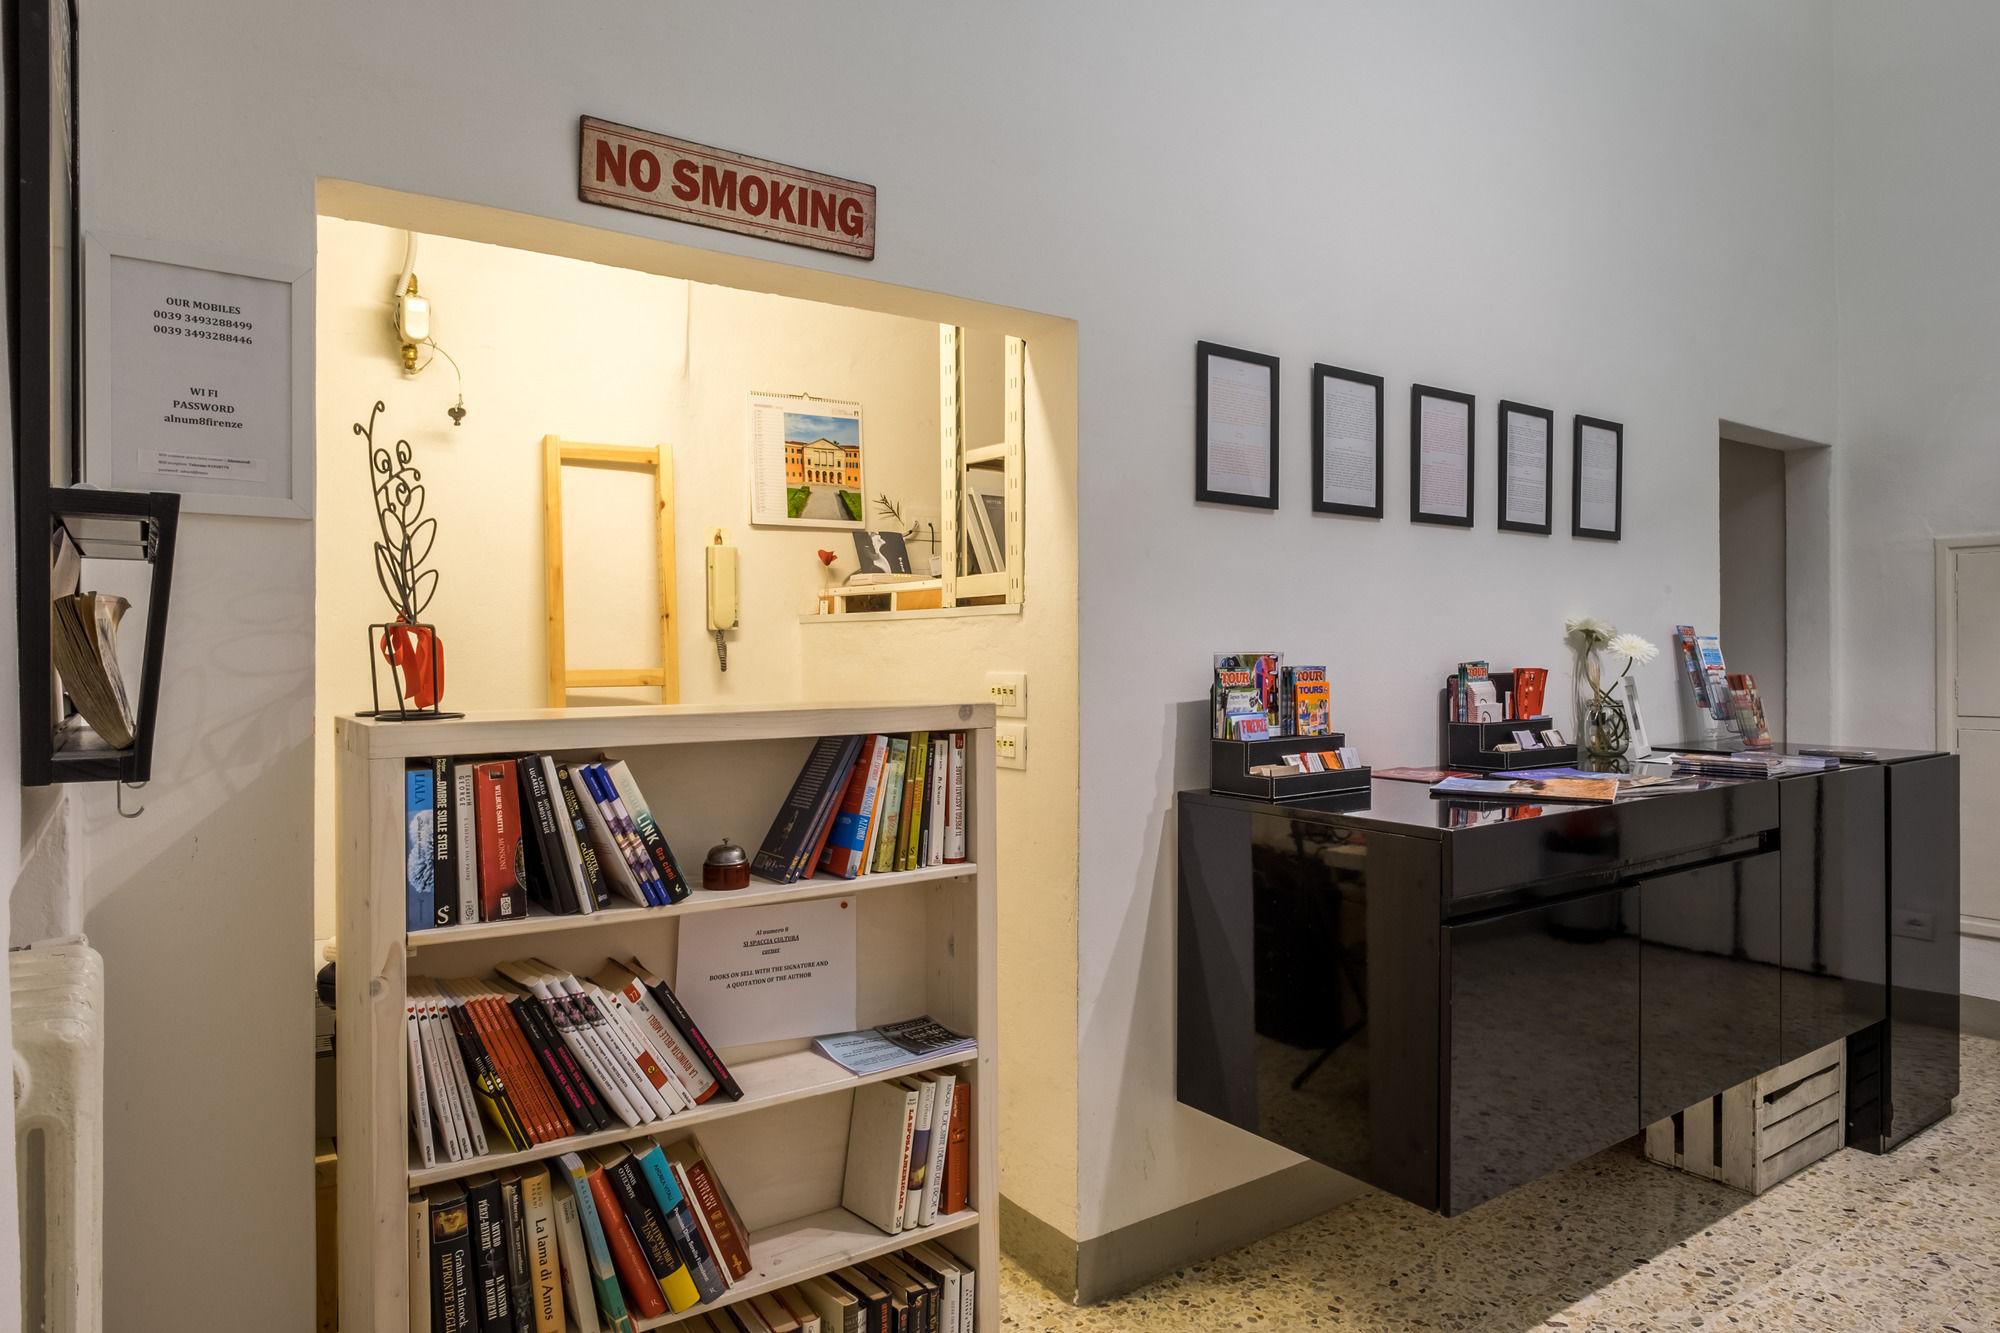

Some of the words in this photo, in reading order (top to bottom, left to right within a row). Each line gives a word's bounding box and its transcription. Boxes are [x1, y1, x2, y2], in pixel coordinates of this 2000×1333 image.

[596, 139, 661, 193] NO
[671, 158, 864, 238] SMOKING
[166, 297, 190, 308] OUR
[193, 301, 241, 315] MOBILES
[153, 309, 182, 321] 0039
[184, 314, 252, 331] 3493288499
[153, 324, 182, 336] 0039
[184, 328, 253, 345] 3493288446
[190, 387, 206, 397] WI
[208, 388, 218, 398] FI
[173, 400, 235, 414] PASSWORD
[163, 414, 243, 429] alnum8firenze
[1220, 672, 1250, 684] TOUR
[1296, 671, 1323, 681] TOUR
[1299, 686, 1323, 694] TOURS
[415, 773, 426, 805] LIALA
[436, 780, 447, 808] OMBRE
[529, 767, 541, 797] LUCARELLI
[537, 777, 546, 796] CARLO
[494, 784, 502, 809] WILBUR
[955, 785, 963, 811] LASCIATI
[437, 809, 447, 833] SULLE
[496, 810, 504, 834] SMITH
[537, 801, 546, 821] ALMOST
[542, 820, 550, 835] BLUE
[636, 814, 660, 846] LINK
[437, 834, 448, 860] STELLE
[586, 847, 597, 871] HOTEL
[580, 842, 598, 884] CALIFORNIA
[773, 935, 799, 944] CULTURA
[709, 972, 730, 981] BOOKS
[740, 970, 754, 978] SELL
[755, 967, 770, 976] WITH
[784, 961, 815, 972] SIGNATURE
[816, 960, 828, 968] AND
[732, 977, 766, 989] QUOTATION
[787, 972, 812, 981] AUTHOR
[646, 1013, 665, 1034] MOGLI
[658, 1029, 676, 1049] DELLE
[669, 1044, 693, 1072] RIVINCITA
[686, 1067, 699, 1079] LA
[908, 1108, 913, 1121] LA
[904, 1122, 912, 1152] SPOSA
[617, 1167, 636, 1200] MARCELLO
[623, 1163, 637, 1187] SIMONI
[898, 1153, 908, 1210] AMERICANA
[492, 1221, 501, 1248] ARTURO
[535, 1217, 546, 1233] La
[537, 1235, 548, 1266] lama
[441, 1253, 454, 1302] IMPRONTE
[455, 1249, 464, 1286] Graham
[540, 1268, 552, 1282] di
[457, 1287, 468, 1328] Hancock
[486, 1287, 497, 1320] SCHERMA
[497, 1284, 507, 1317] MAESTRO
[541, 1284, 554, 1321] Amos
